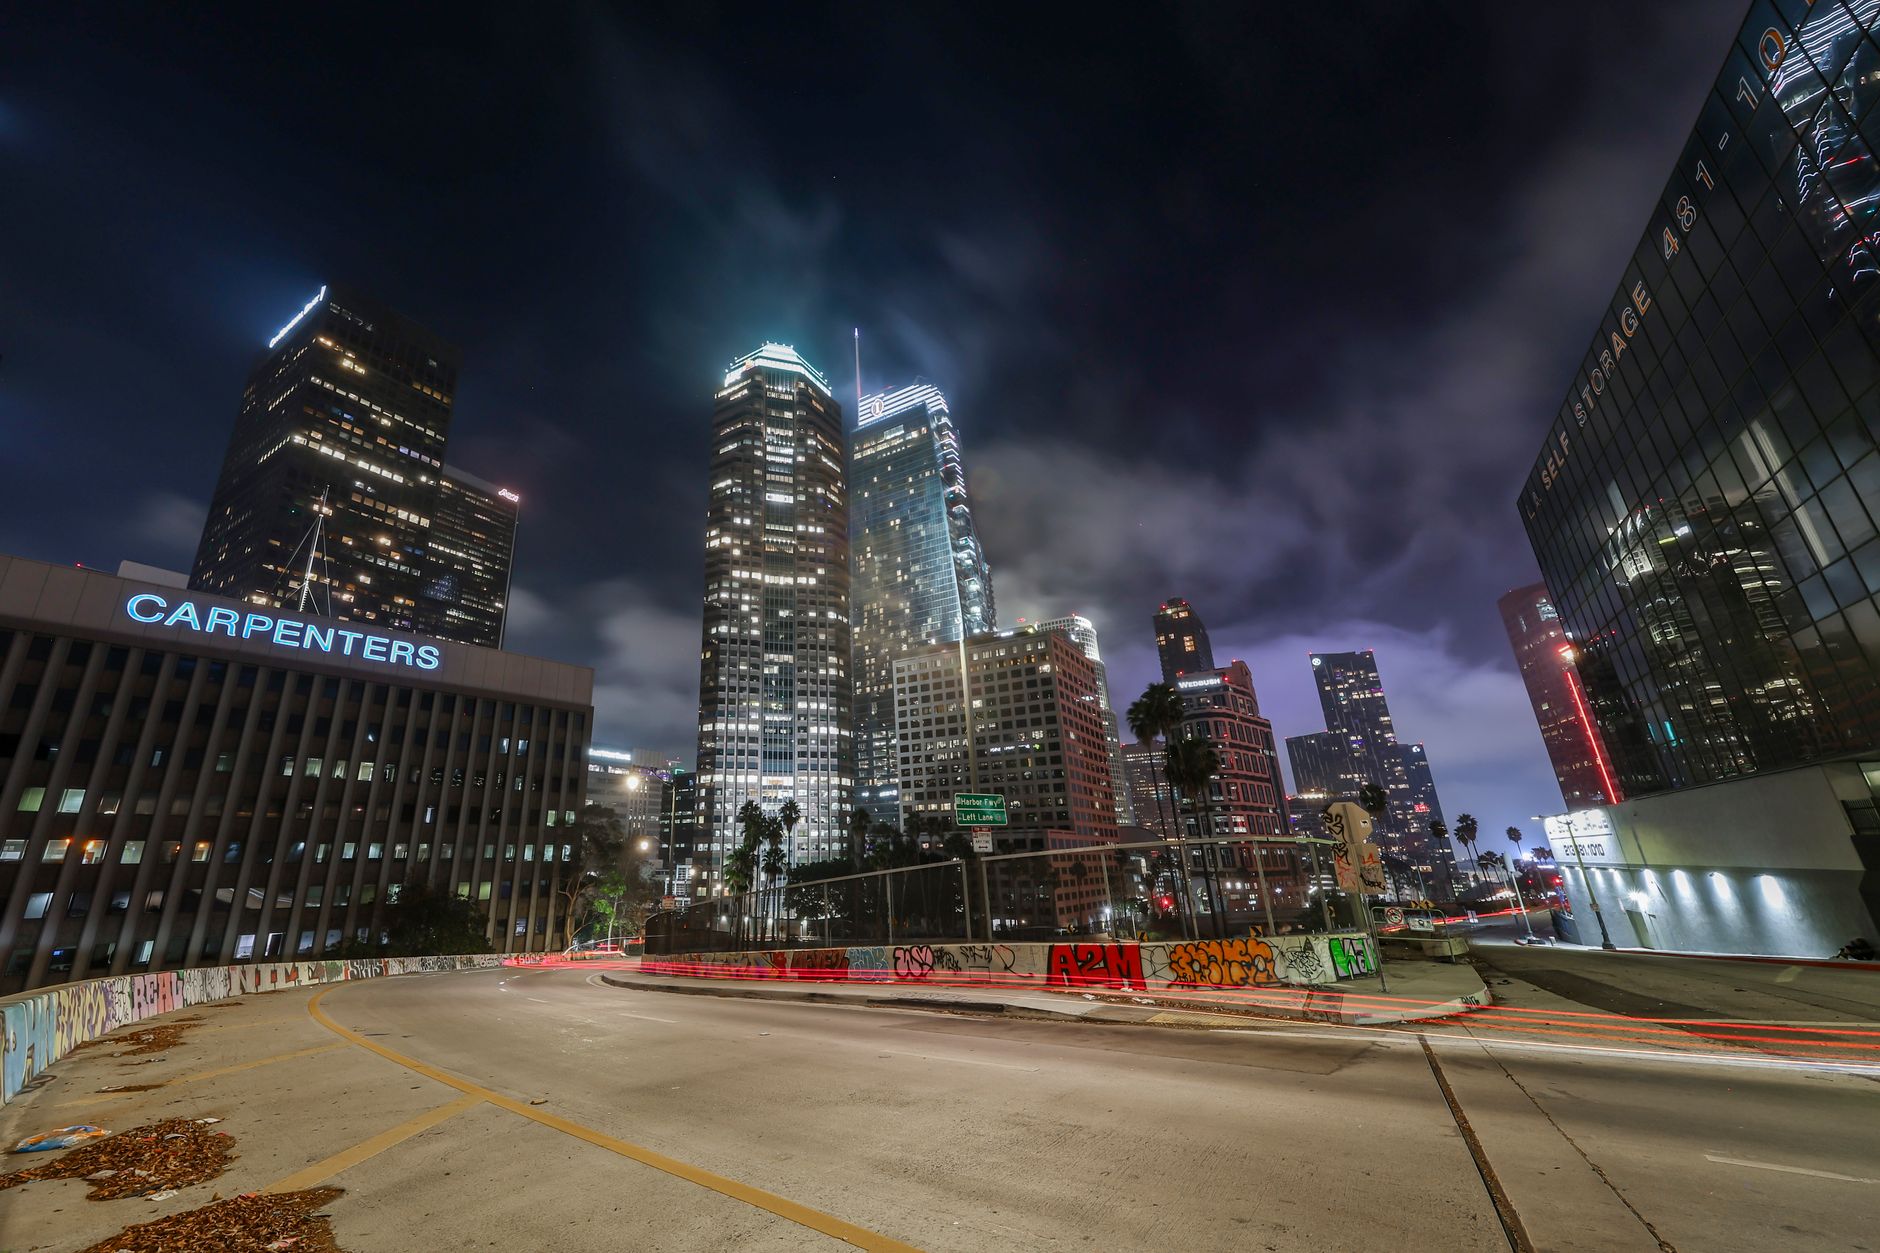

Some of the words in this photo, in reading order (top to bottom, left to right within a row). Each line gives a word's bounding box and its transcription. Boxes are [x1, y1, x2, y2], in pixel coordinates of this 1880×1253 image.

[1541, 431, 1569, 490] SELF
[1573, 280, 1651, 428] STORAGE
[126, 593, 441, 670] CARPENTERS
[960, 797, 982, 806] Harbor
[984, 798, 997, 807] Fwy
[962, 813, 976, 821] Left
[978, 813, 993, 821] Lane
[1046, 944, 1147, 990] A2M
[132, 971, 184, 1021] REAL
